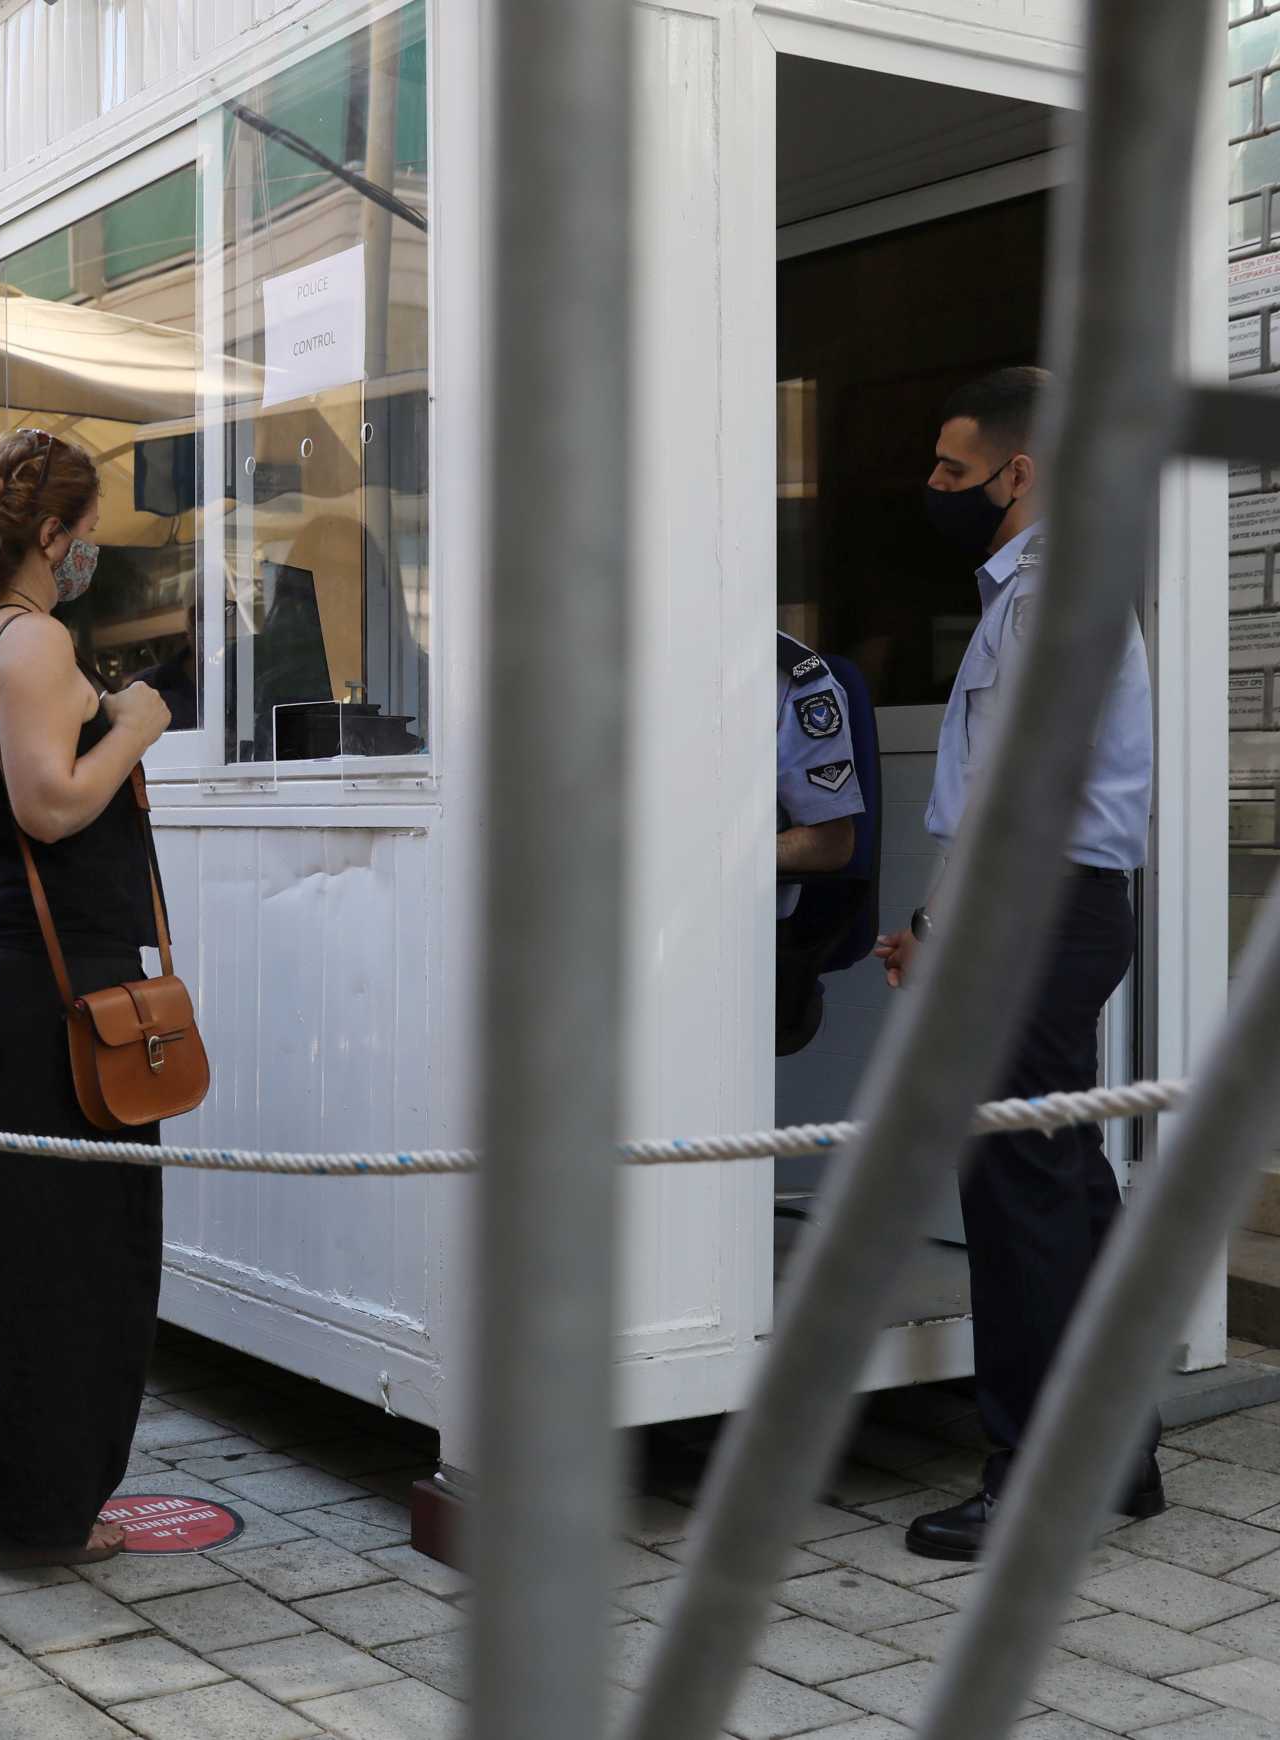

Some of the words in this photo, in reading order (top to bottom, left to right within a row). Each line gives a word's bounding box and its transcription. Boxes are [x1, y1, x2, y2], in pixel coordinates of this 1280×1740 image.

[297, 276, 329, 301] POLICE
[292, 329, 336, 357] CONTROL
[134, 1498, 192, 1515] WAIT
[122, 1510, 217, 1532] ΠΕΡΙΜΕΝΕΤΕ
[173, 1527, 187, 1536] 2
